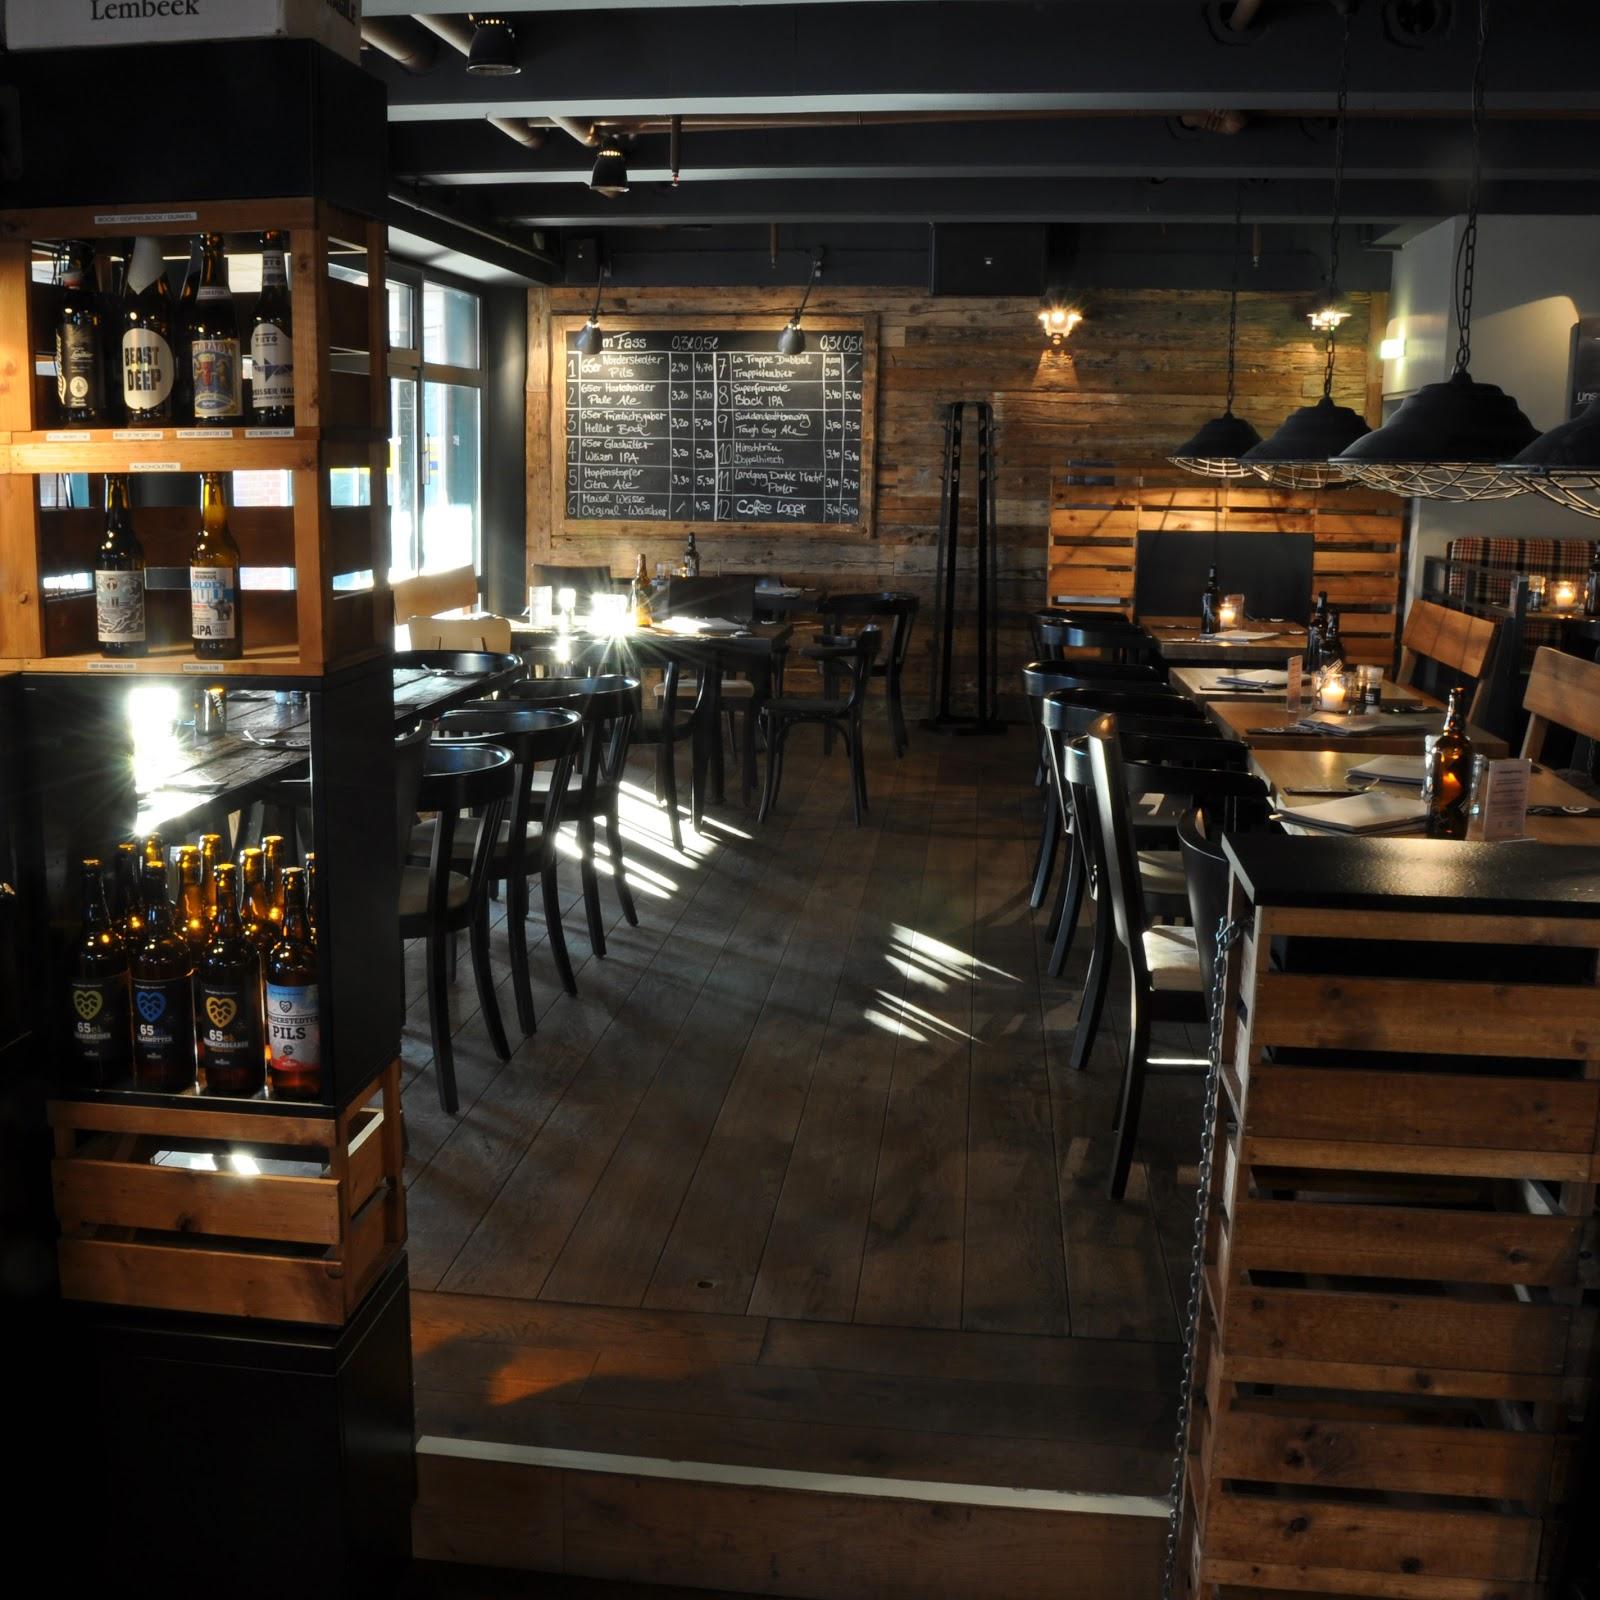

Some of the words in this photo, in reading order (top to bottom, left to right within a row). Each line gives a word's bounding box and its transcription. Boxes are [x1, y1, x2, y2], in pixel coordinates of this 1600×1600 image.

[91, 0, 199, 20] Lembeek
[613, 332, 647, 349] Fass
[125, 346, 159, 366] BEAST
[732, 355, 743, 363] La
[608, 367, 634, 378] Pils
[718, 358, 727, 378] 7
[127, 368, 161, 391] DEEP
[567, 387, 576, 405] 2
[587, 395, 612, 405] Pale
[616, 395, 642, 405] Ale
[671, 390, 689, 401] 3,20
[695, 389, 713, 401] 5,20
[719, 385, 729, 405] 8
[735, 396, 763, 406] Black
[768, 396, 784, 407] IPA
[825, 389, 842, 400] 3,40
[845, 390, 861, 401] 5,40
[567, 413, 577, 432] 3
[617, 424, 651, 436] Bock
[671, 418, 689, 429] 3,20
[694, 417, 713, 430] 5,20
[718, 413, 728, 432] 9
[736, 424, 759, 437] Tough
[761, 423, 777, 438] Guy
[780, 424, 808, 436] Ale
[567, 440, 577, 460] 4
[619, 453, 639, 464] IPA
[672, 449, 689, 459] 3,20
[696, 449, 714, 460] 5,20
[718, 443, 732, 464] 10
[568, 469, 577, 486] 5
[584, 480, 609, 489] Citra
[613, 481, 640, 489] Ale
[696, 475, 714, 486] 5,30
[718, 470, 731, 492] 11
[567, 496, 575, 514] 6
[718, 499, 732, 521] 12
[736, 499, 772, 516] Coffee
[197, 625, 212, 636] IPA
[273, 1026, 306, 1040] PILS
